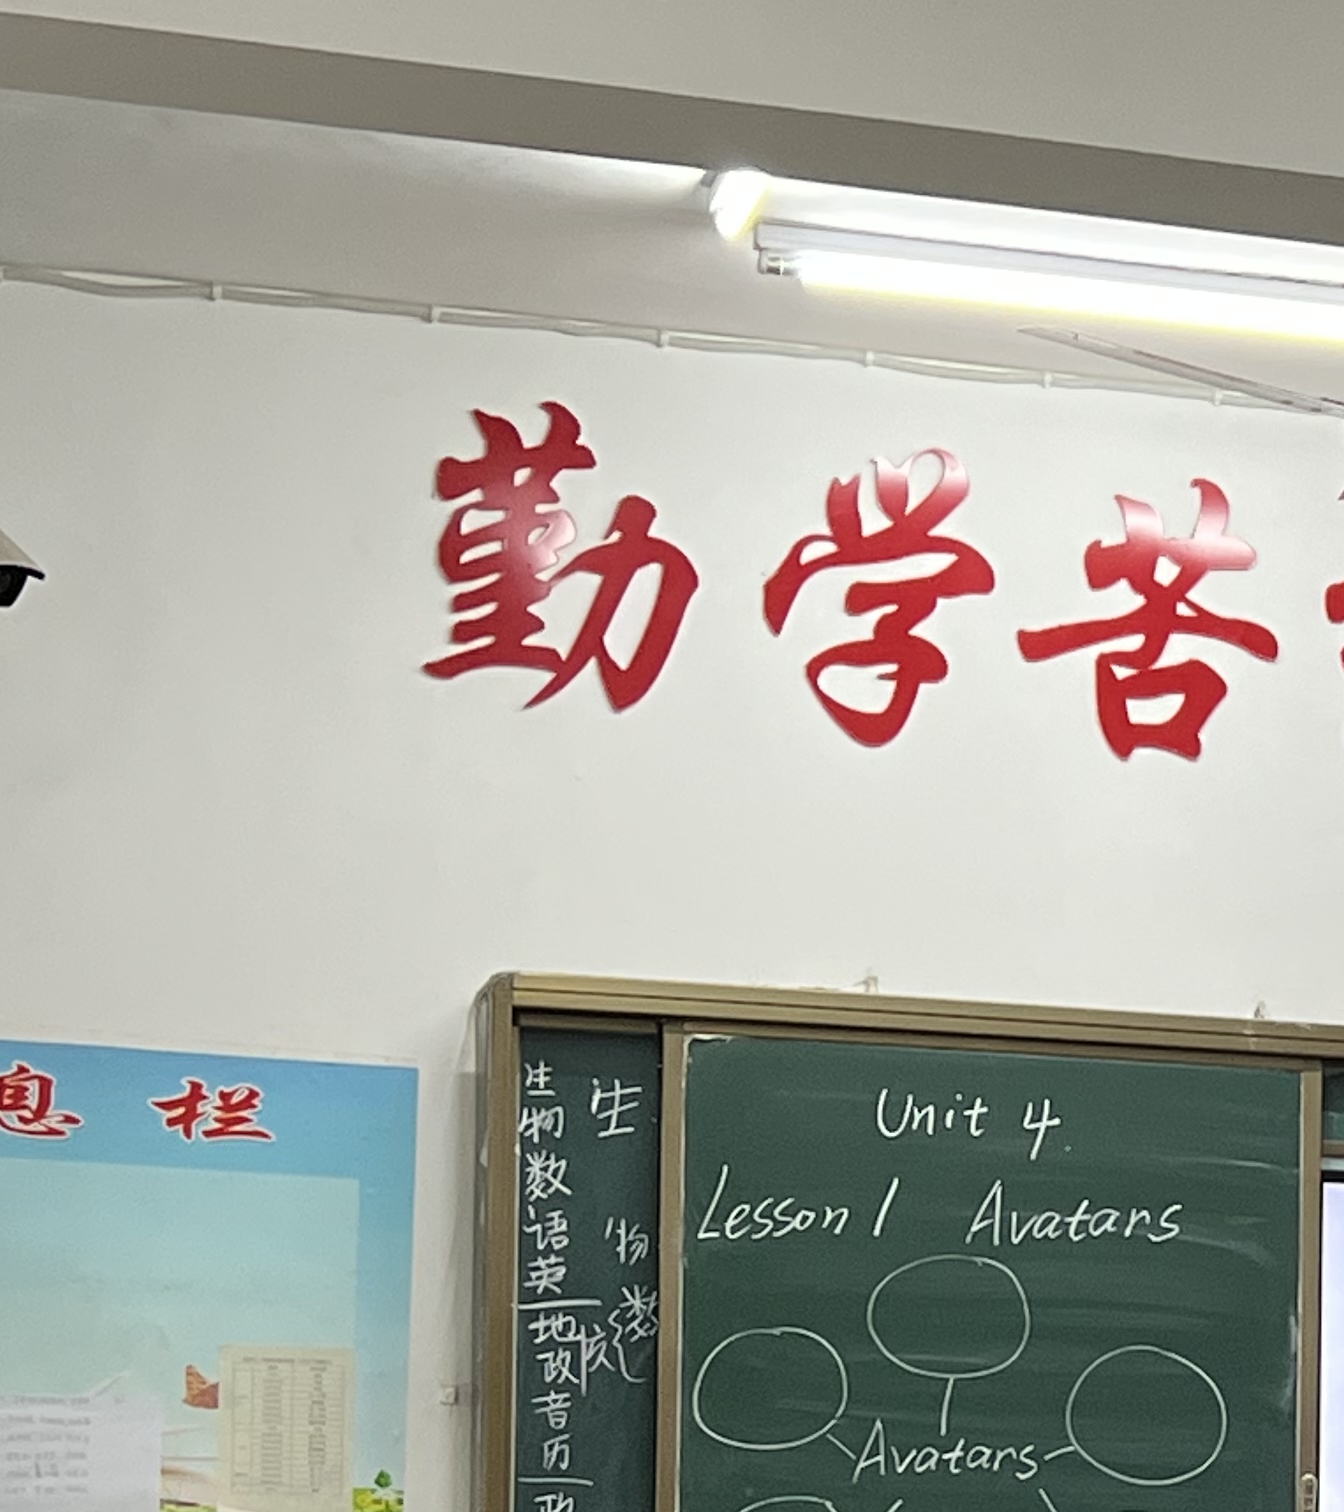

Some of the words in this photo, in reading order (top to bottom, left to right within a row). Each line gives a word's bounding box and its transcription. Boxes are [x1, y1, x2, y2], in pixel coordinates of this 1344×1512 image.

[0, 1063, 273, 1141] 息栏
[876, 1088, 989, 1138] Unit
[1022, 1098, 1062, 1161] 4
[697, 1164, 849, 1240] Lesson
[965, 1179, 1183, 1246] Avatars
[853, 1418, 1039, 1483] Avatars
